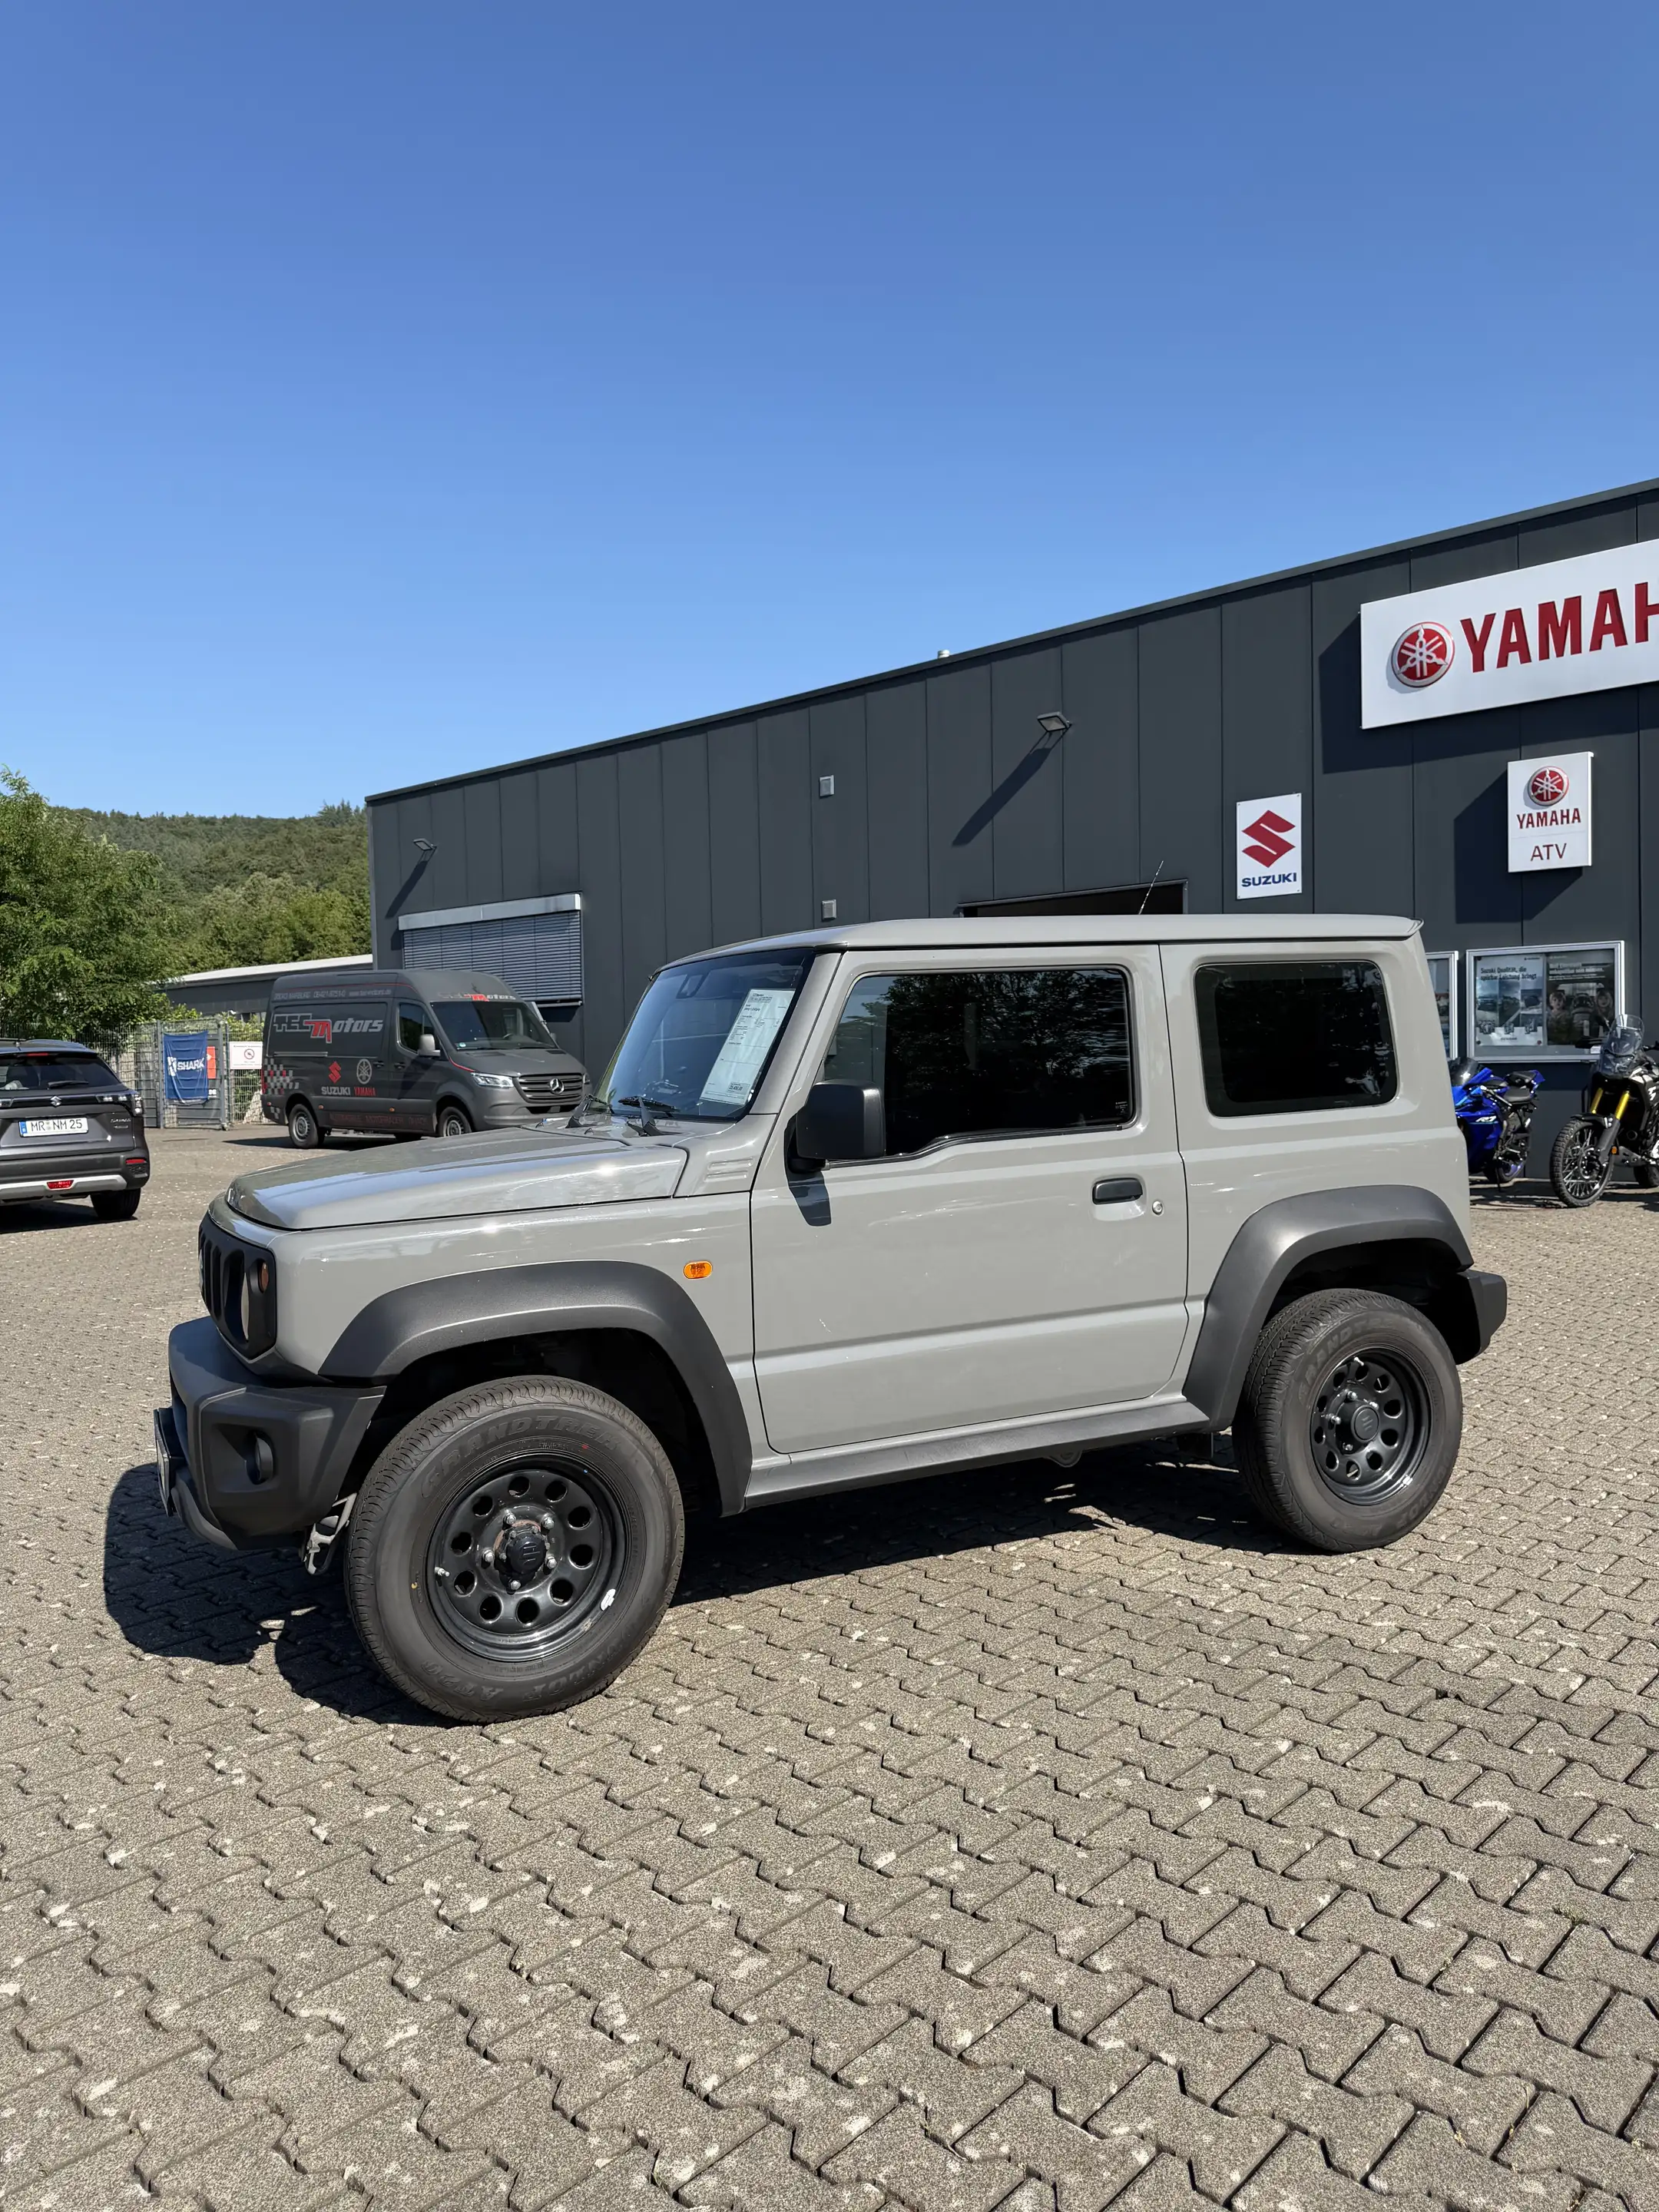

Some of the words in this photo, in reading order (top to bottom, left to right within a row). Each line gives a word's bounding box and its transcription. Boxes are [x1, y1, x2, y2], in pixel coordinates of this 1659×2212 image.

[1459, 581, 1659, 673] YAMAH
[1516, 808, 1581, 830] YAMAHA
[1530, 843, 1567, 862] ATV
[1241, 872, 1297, 887] SUZUKI
[177, 1057, 204, 1071] SHARK
[321, 1086, 351, 1095] SUZUKI
[353, 1086, 377, 1096] YAMAHA
[31, 1121, 45, 1131] MR
[53, 1120, 67, 1131] NM
[69, 1118, 82, 1129] 25
[421, 1415, 621, 1498] GRANDTREK
